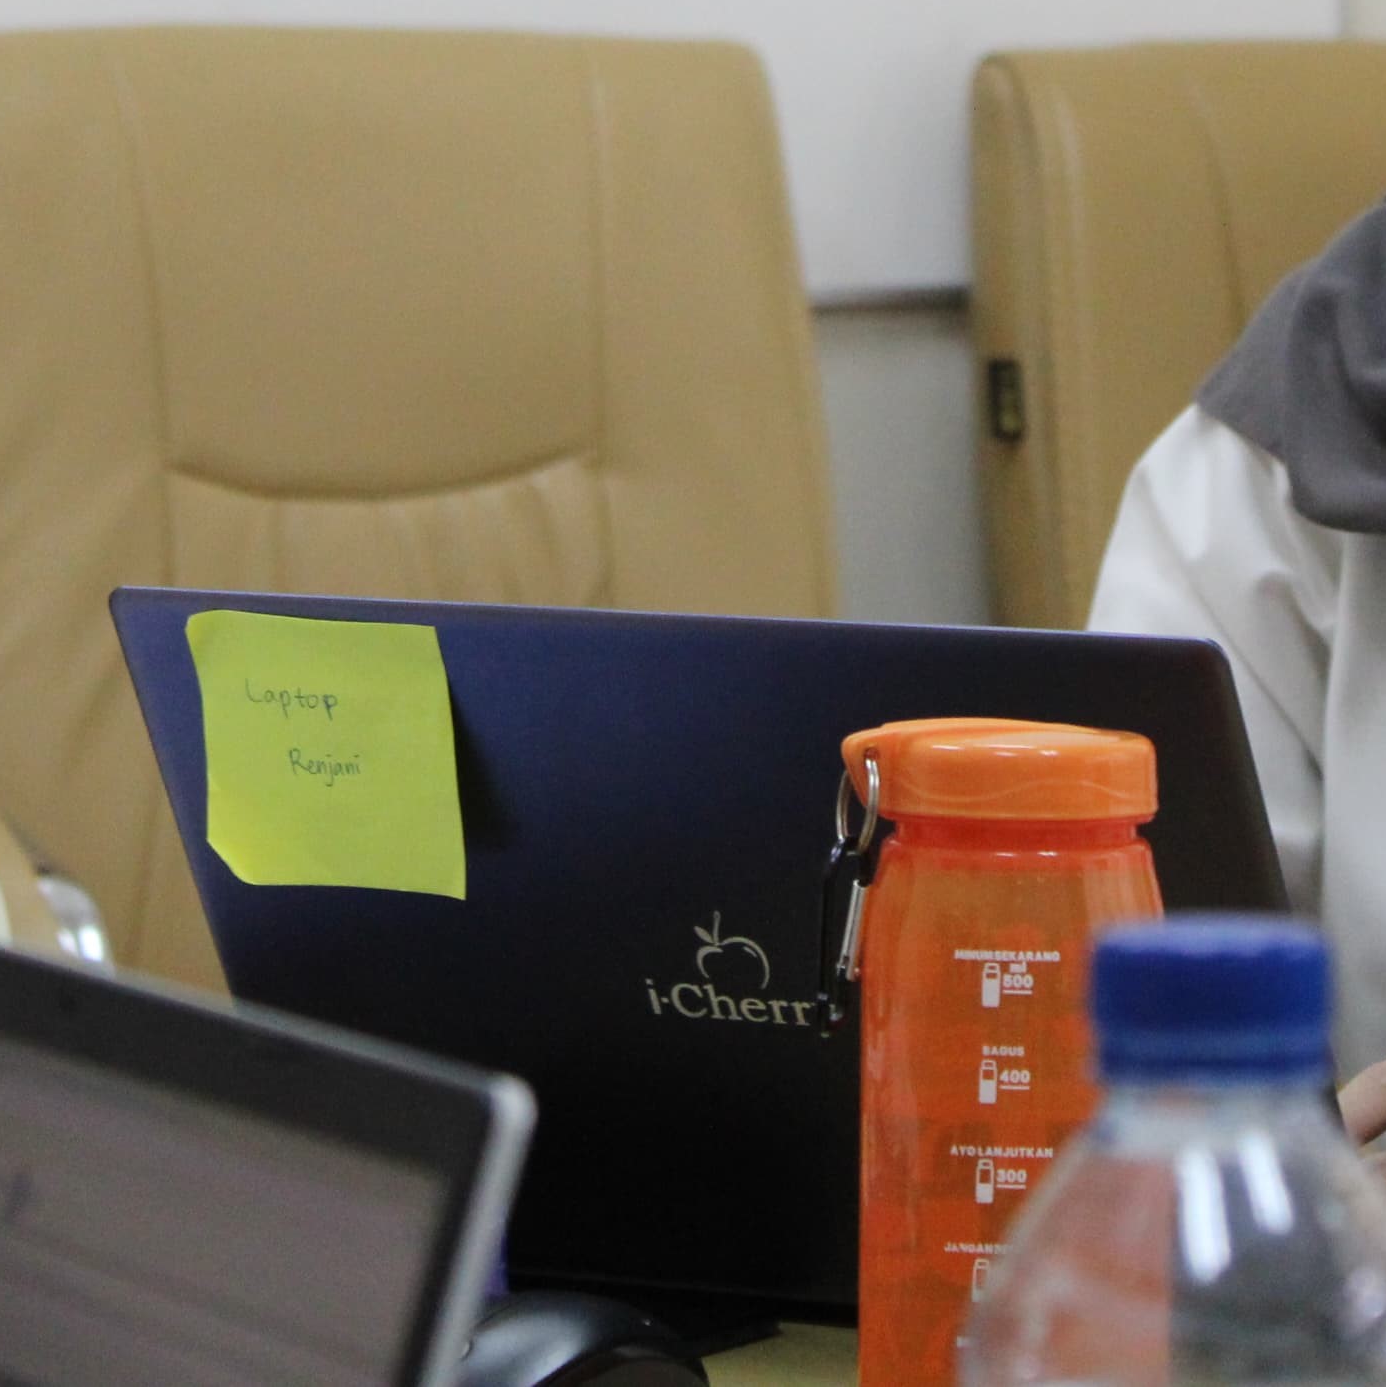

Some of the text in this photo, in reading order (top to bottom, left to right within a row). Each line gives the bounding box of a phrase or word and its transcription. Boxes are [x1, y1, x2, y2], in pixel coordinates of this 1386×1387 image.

[244, 678, 338, 721] Laptop
[289, 748, 361, 787] Renjani
[1003, 974, 1034, 989] 500
[982, 1045, 1025, 1057] BAGUS
[1000, 1069, 1031, 1084] 400
[950, 1144, 1054, 1159] AYO LANJUTKAN
[996, 1169, 1028, 1183] 300
